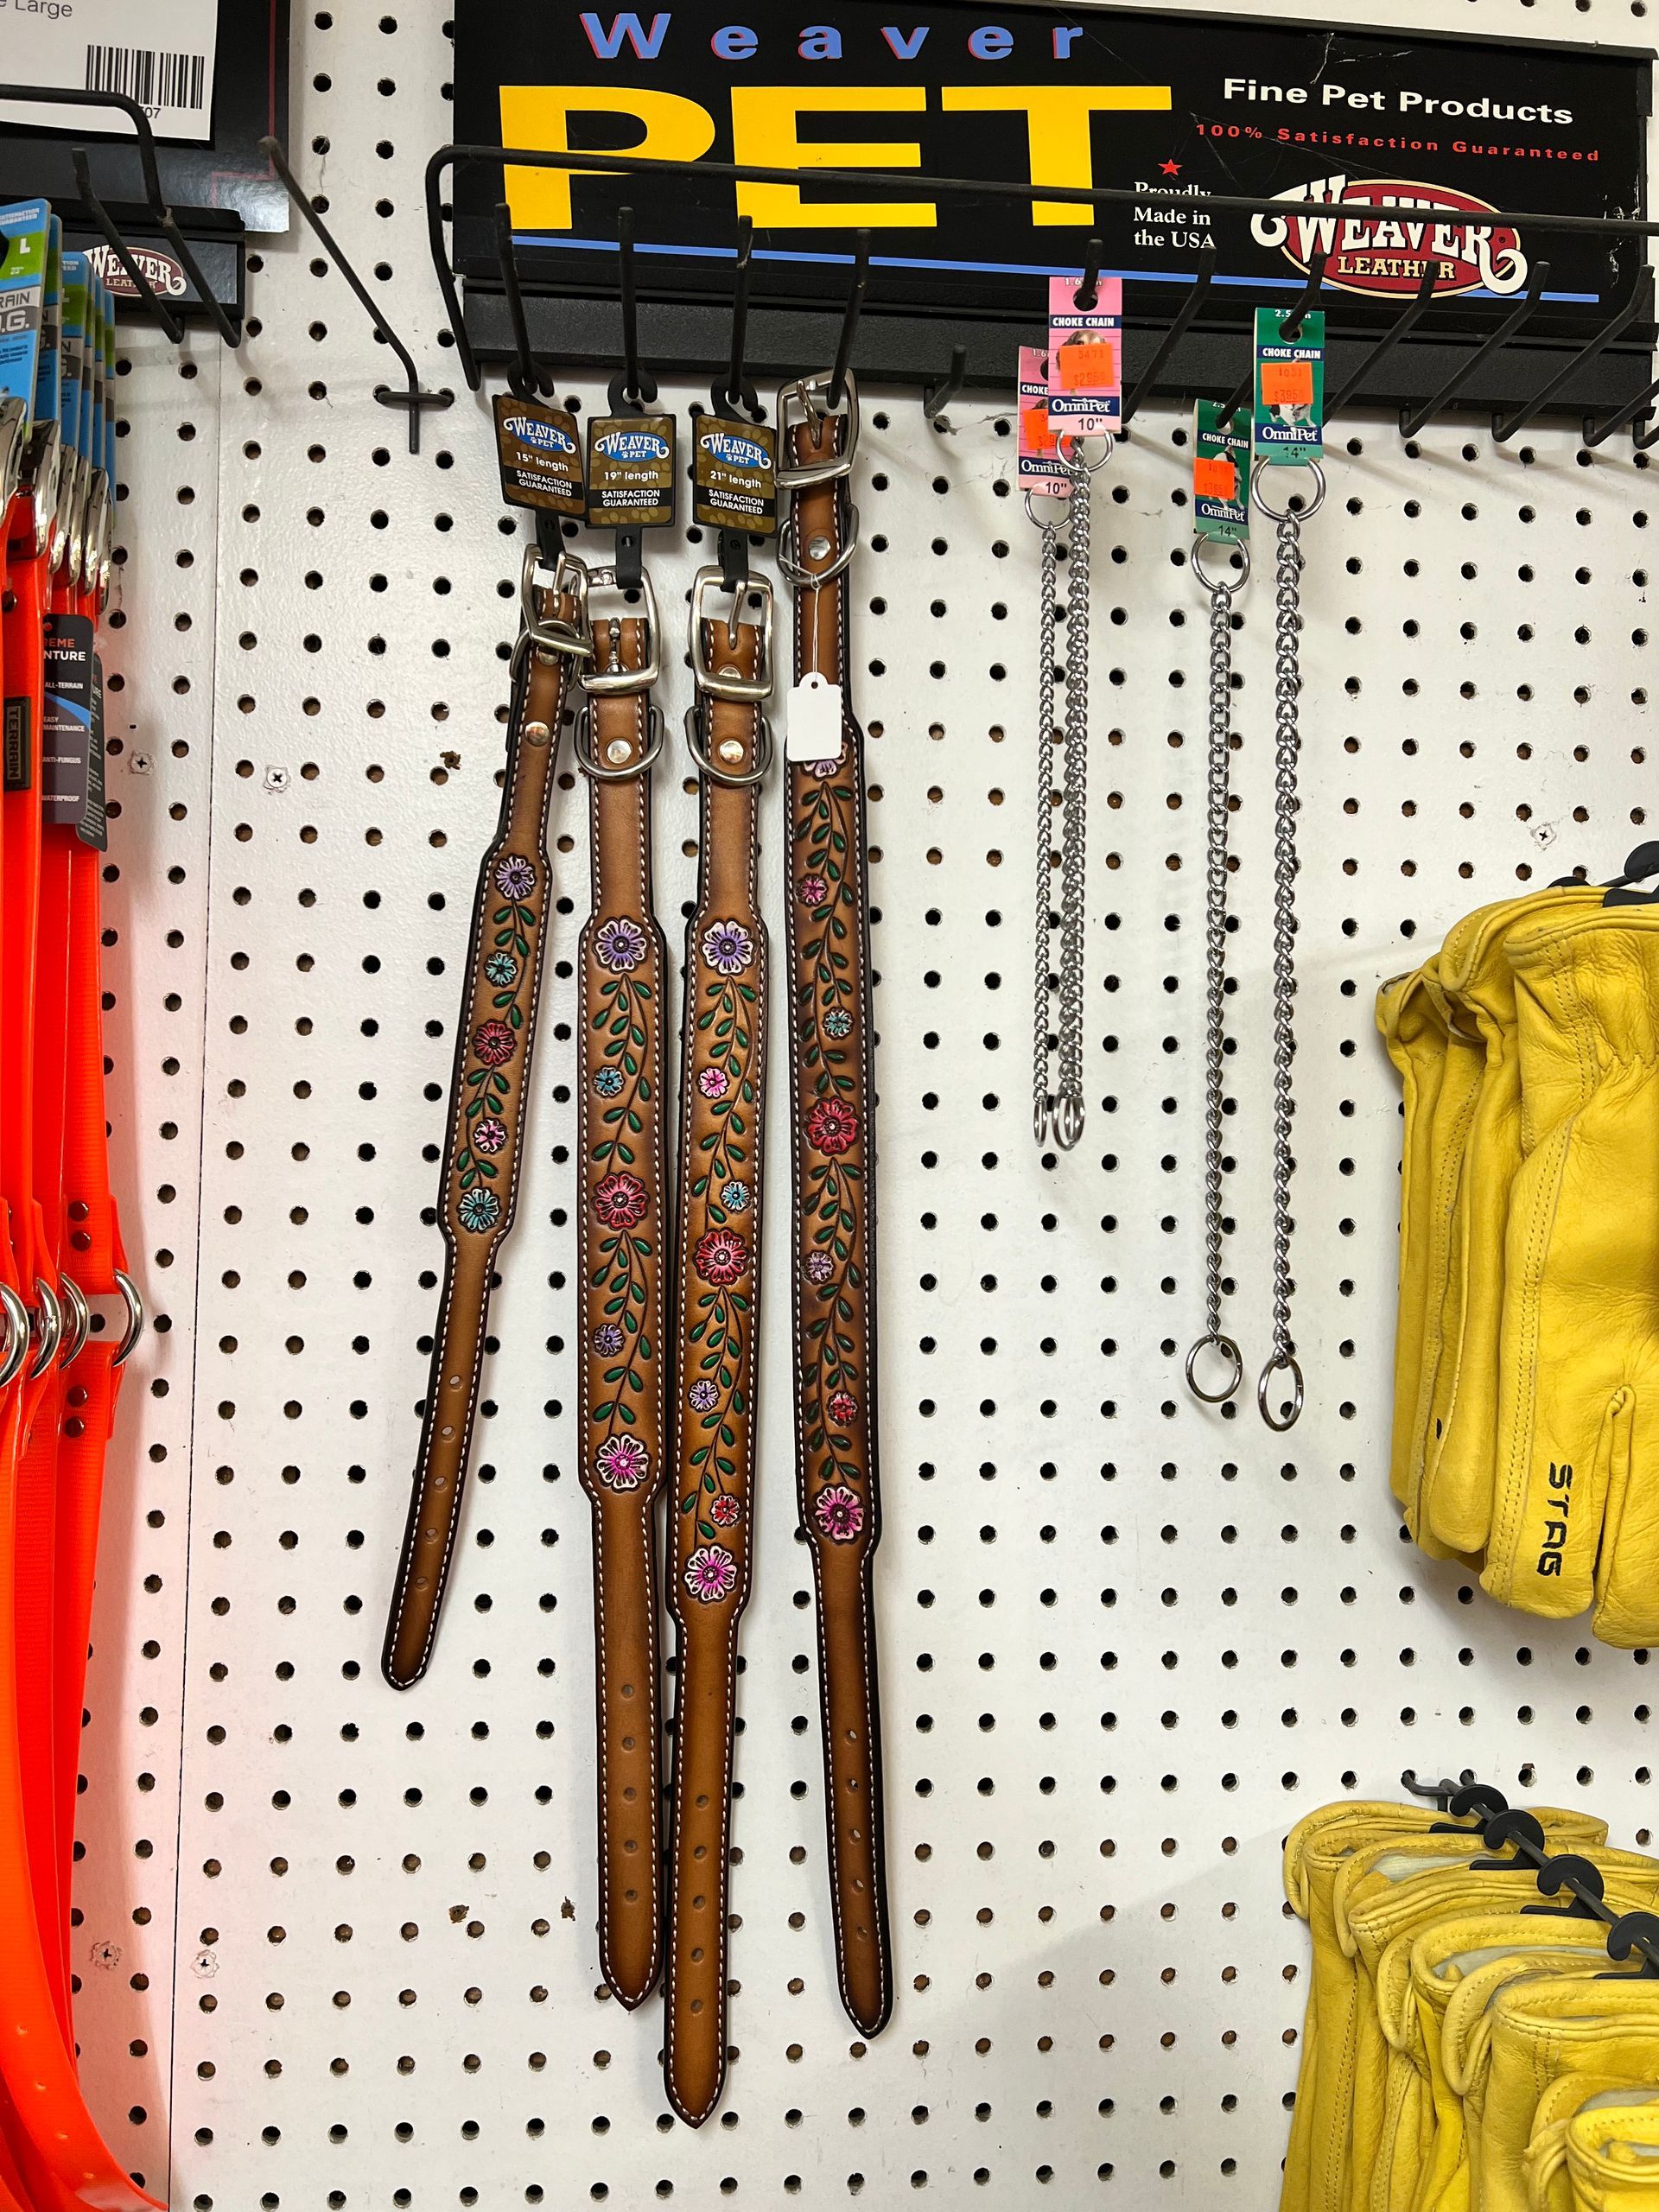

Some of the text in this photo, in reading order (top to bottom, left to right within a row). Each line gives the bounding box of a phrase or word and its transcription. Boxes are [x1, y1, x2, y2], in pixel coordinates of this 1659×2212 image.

[15, 0, 73, 19] Large
[581, 12, 1084, 60] Weaver
[1224, 78, 1573, 124] Fine Pet Products
[1196, 124, 1599, 162] 100% Satisfaction Guaranteed
[499, 85, 1172, 230] PET
[1134, 207, 1211, 226] Made in
[1134, 228, 1217, 249] the USA
[1251, 175, 1528, 294] WEAVER
[20, 238, 31, 254] L
[1338, 257, 1454, 279] LEATHR
[106, 277, 156, 289] LEATR
[1052, 317, 1115, 327] CHOKE CHAIN
[1262, 347, 1321, 359] CHOKE CHAIN
[1021, 384, 1048, 395] CHOKE
[1052, 398, 1110, 413] OmniPet
[1077, 417, 1103, 430] 10"
[503, 416, 576, 454] WEAVER
[1202, 432, 1249, 449] CHOKE CHAIN
[1262, 426, 1318, 442] OmniPet
[537, 439, 555, 448] PET
[594, 431, 670, 460] WEAVER
[700, 433, 772, 470] WEAVER
[516, 451, 569, 473] 15" length
[733, 455, 750, 465] PET
[1020, 459, 1071, 476] OmniPet
[516, 469, 572, 490] SATISFACTION
[604, 471, 659, 482] 19" length
[710, 470, 762, 489] 21" length
[518, 478, 572, 497] GUARANTEED
[601, 489, 660, 499] SATISFACTION
[1045, 481, 1067, 494] 10"
[602, 498, 658, 507] GUARANTEED
[709, 488, 765, 507] SATISFACTION
[709, 498, 763, 515] GUARANTEED
[1201, 502, 1245, 523] OmniPet
[1218, 524, 1236, 537] 14"
[45, 681, 84, 690] ALL-TERRAIN
[1536, 1461, 1573, 1577] STAG
